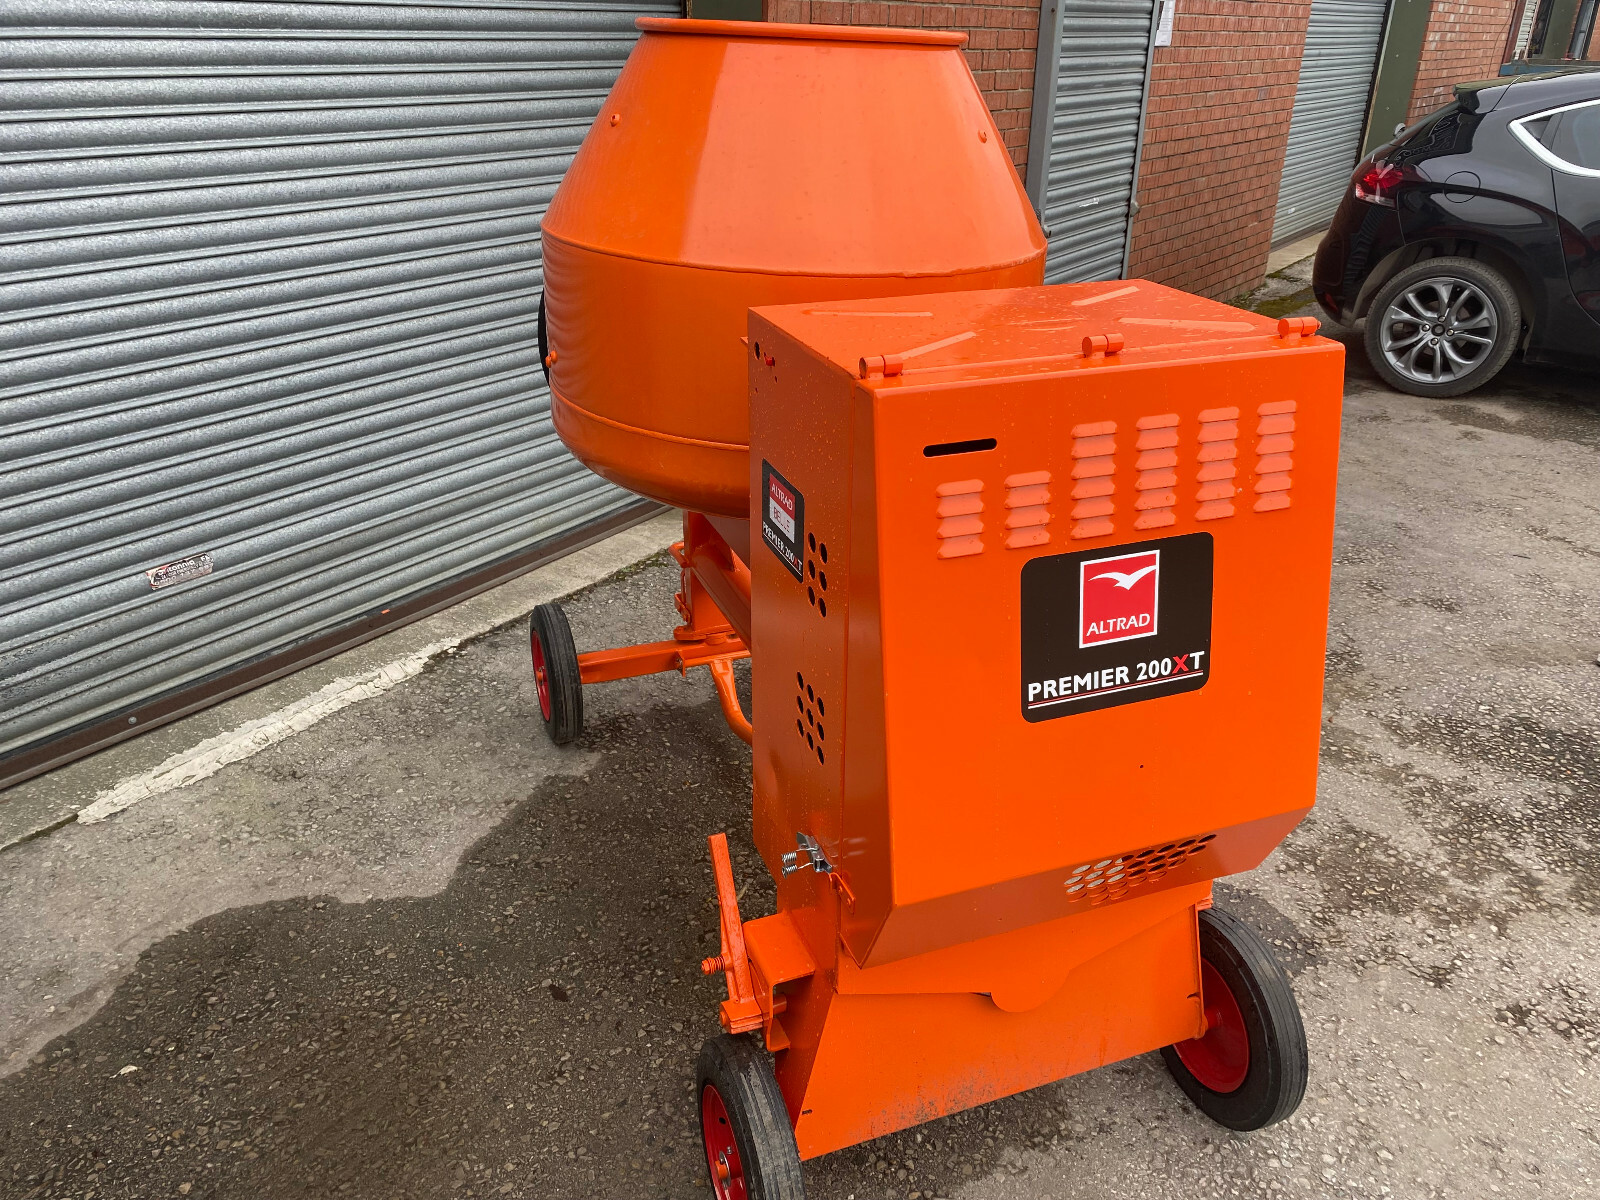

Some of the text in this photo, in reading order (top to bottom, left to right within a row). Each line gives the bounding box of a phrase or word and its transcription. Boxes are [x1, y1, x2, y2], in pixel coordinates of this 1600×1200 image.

[771, 483, 793, 511] ALTRAD
[773, 507, 790, 533] BELLE
[762, 521, 803, 571] PREMIER 200XT
[1086, 613, 1151, 637] ALTRAD
[1028, 651, 1205, 702] PREMIER 200XT
